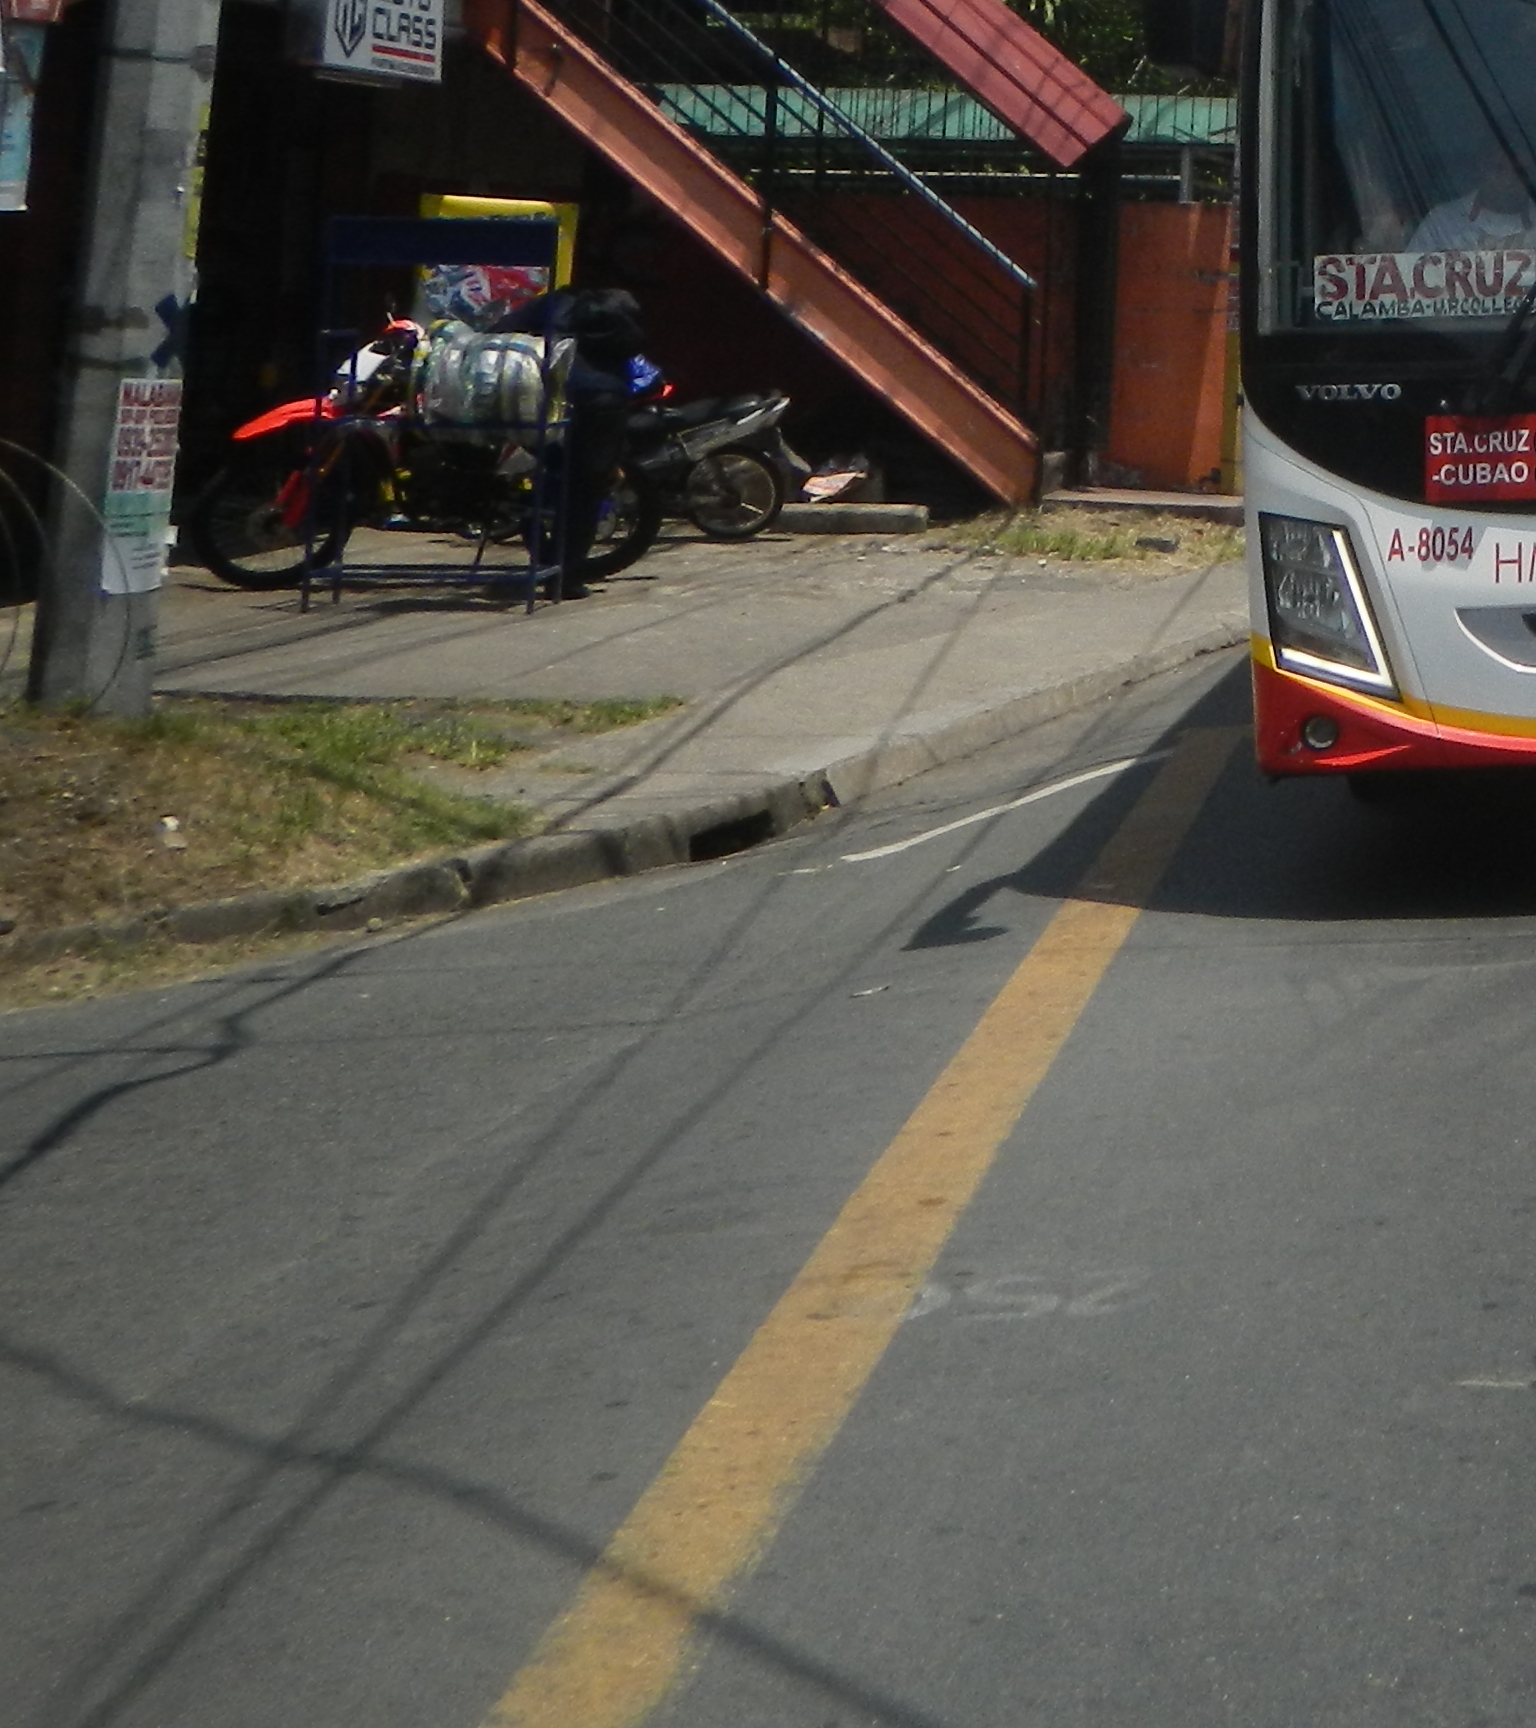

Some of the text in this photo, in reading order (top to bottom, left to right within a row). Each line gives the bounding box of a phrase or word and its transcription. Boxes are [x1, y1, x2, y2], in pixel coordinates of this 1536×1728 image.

[372, 6, 437, 50] CLASS
[1295, 382, 1402, 402] VOLVO
[1431, 460, 1529, 486] -CUBAO
[1387, 526, 1474, 563] A-8054
